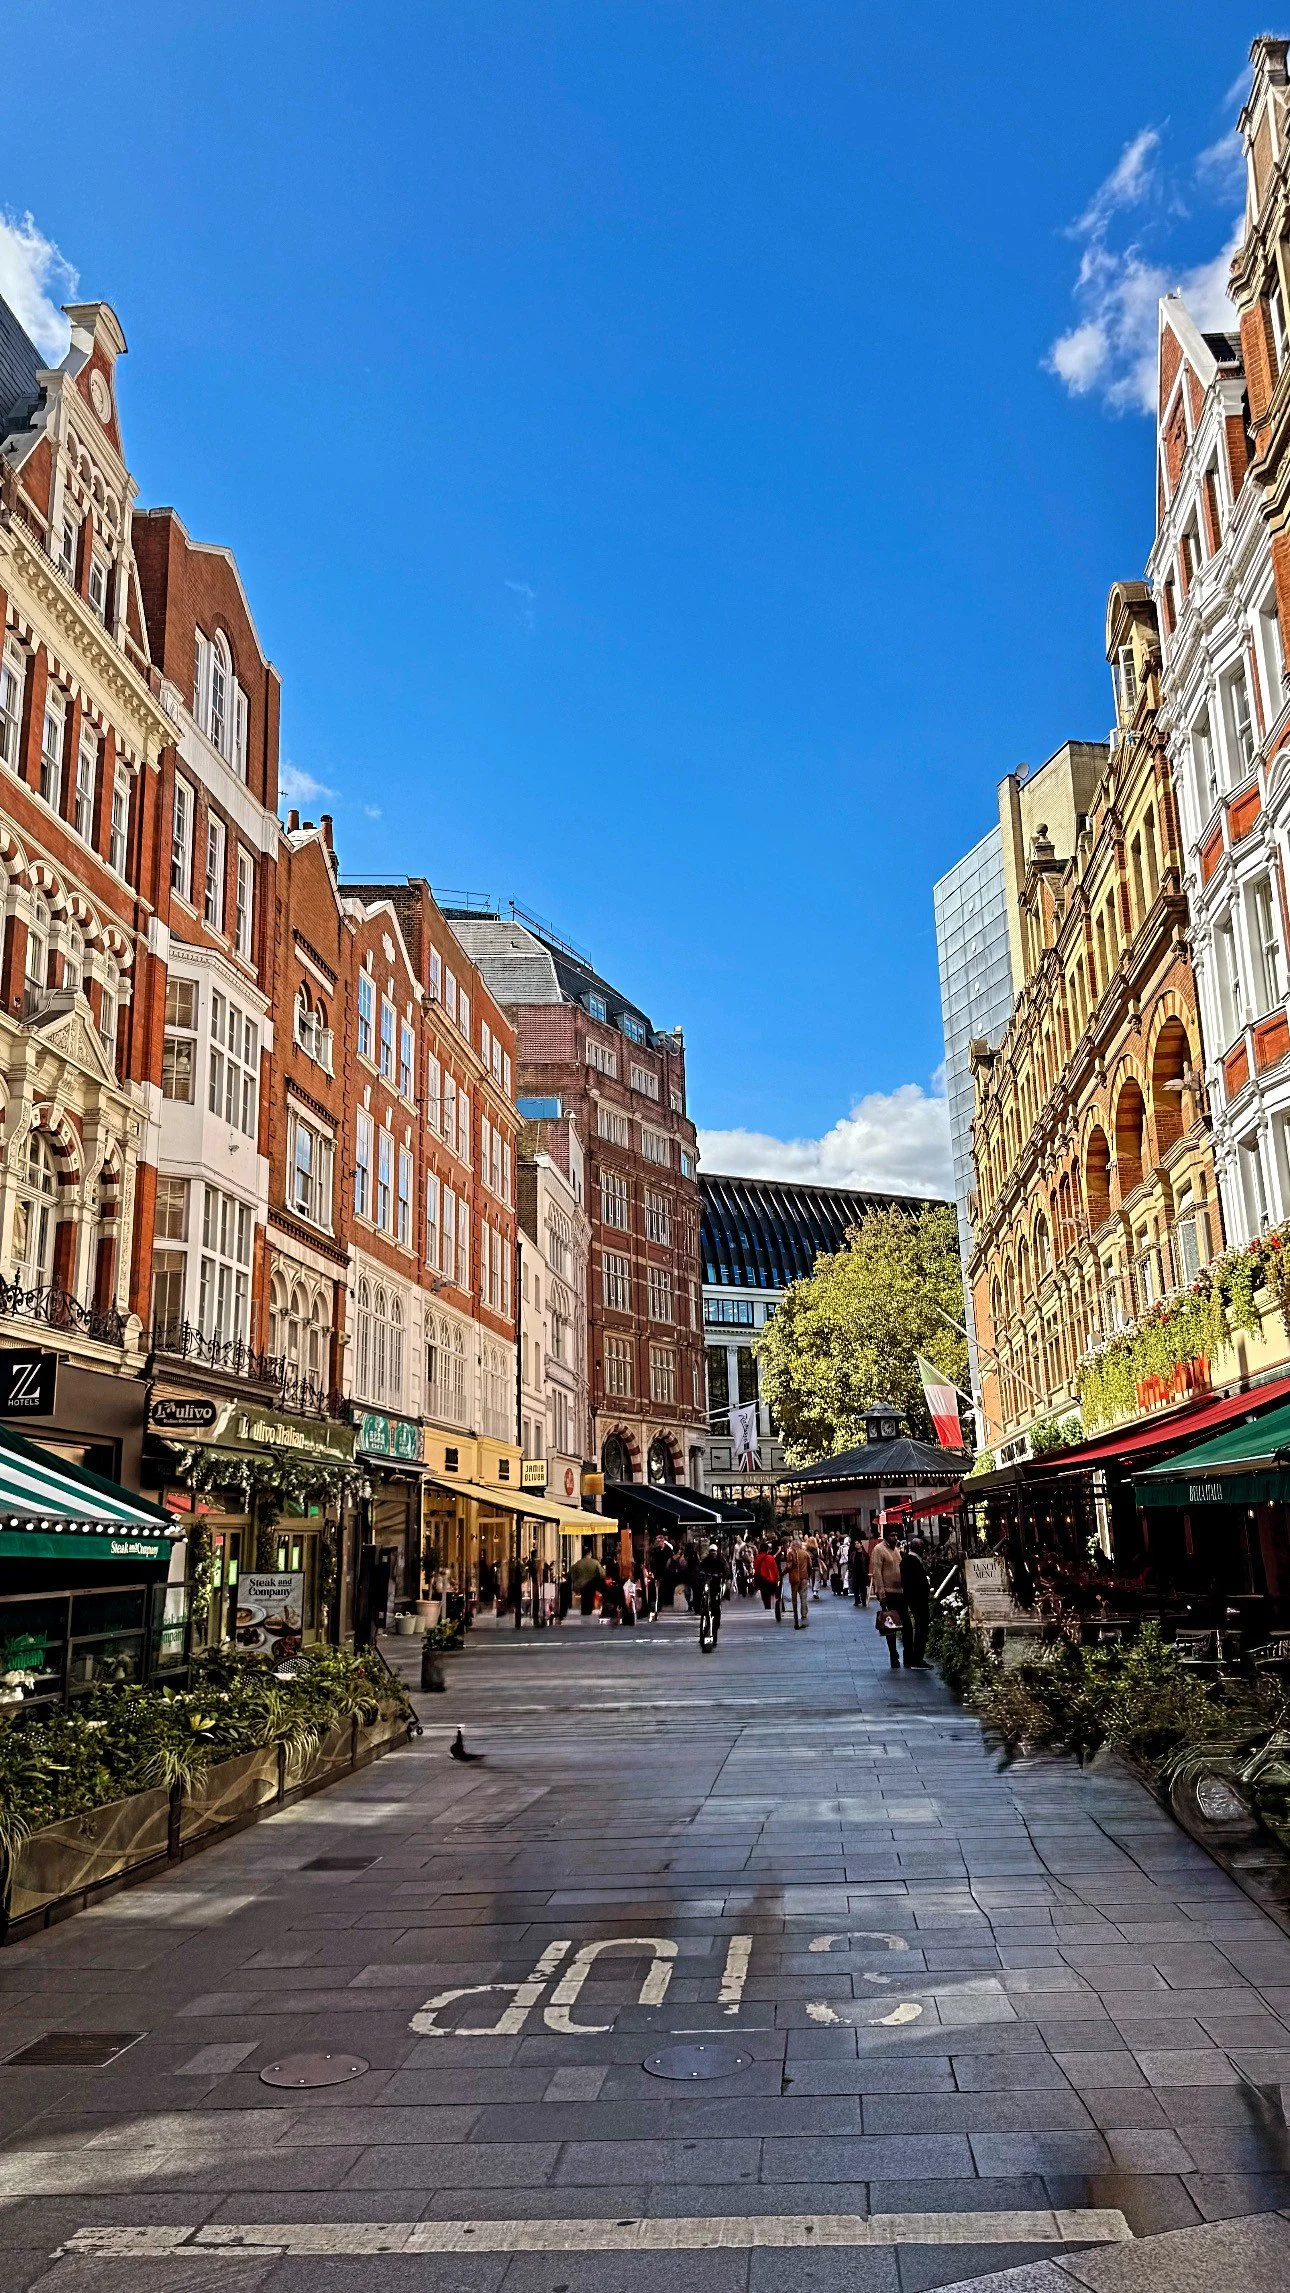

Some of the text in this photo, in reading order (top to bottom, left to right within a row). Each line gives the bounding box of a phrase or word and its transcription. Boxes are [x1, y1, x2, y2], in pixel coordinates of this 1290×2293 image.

[9, 1364, 41, 1399] Z
[524, 1473, 545, 1482] OLIVER
[111, 1540, 129, 1554] Steak
[249, 1578, 293, 1588] Steak and
[248, 1586, 291, 1599] Company
